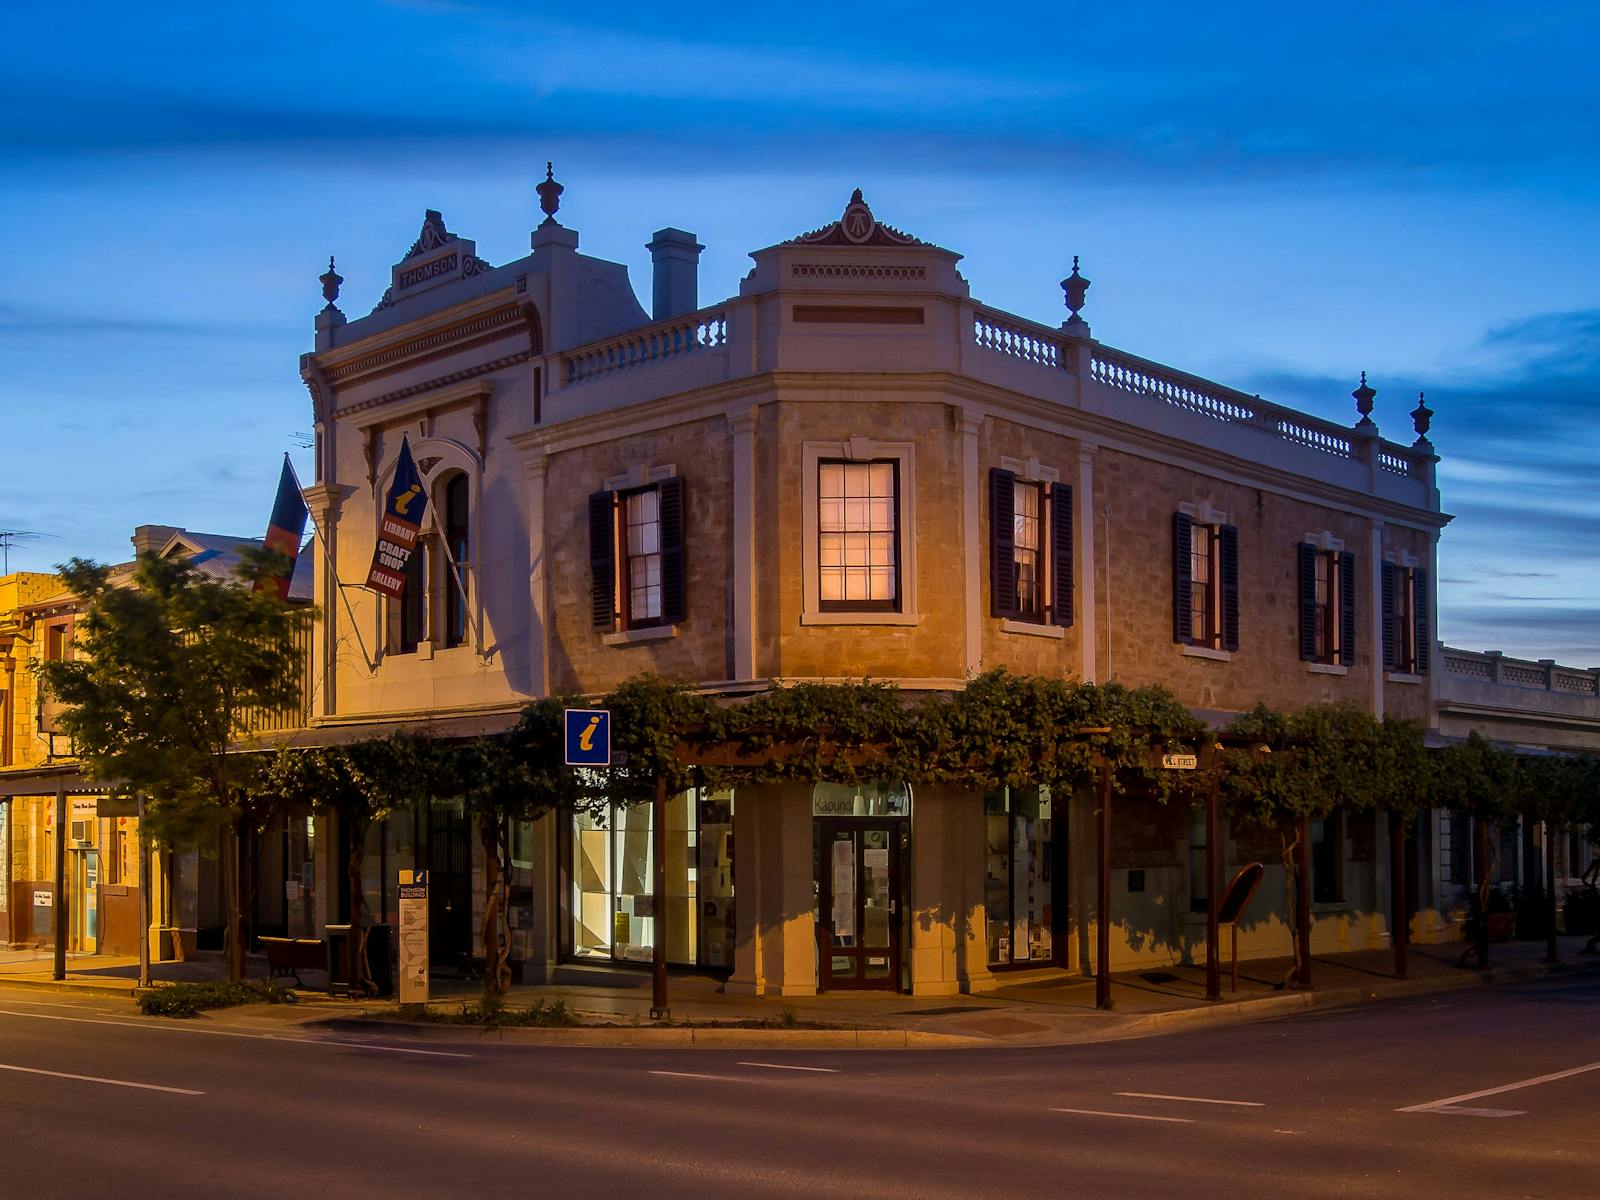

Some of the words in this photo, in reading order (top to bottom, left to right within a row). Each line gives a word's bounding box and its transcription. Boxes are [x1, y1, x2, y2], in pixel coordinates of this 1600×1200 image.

[401, 255, 457, 288] THOMSON
[383, 520, 416, 542] LIBRARY
[378, 540, 412, 562] CRAFT
[379, 552, 404, 571] SHOP
[370, 569, 402, 592] GALLERY
[814, 798, 854, 814] Kapund
